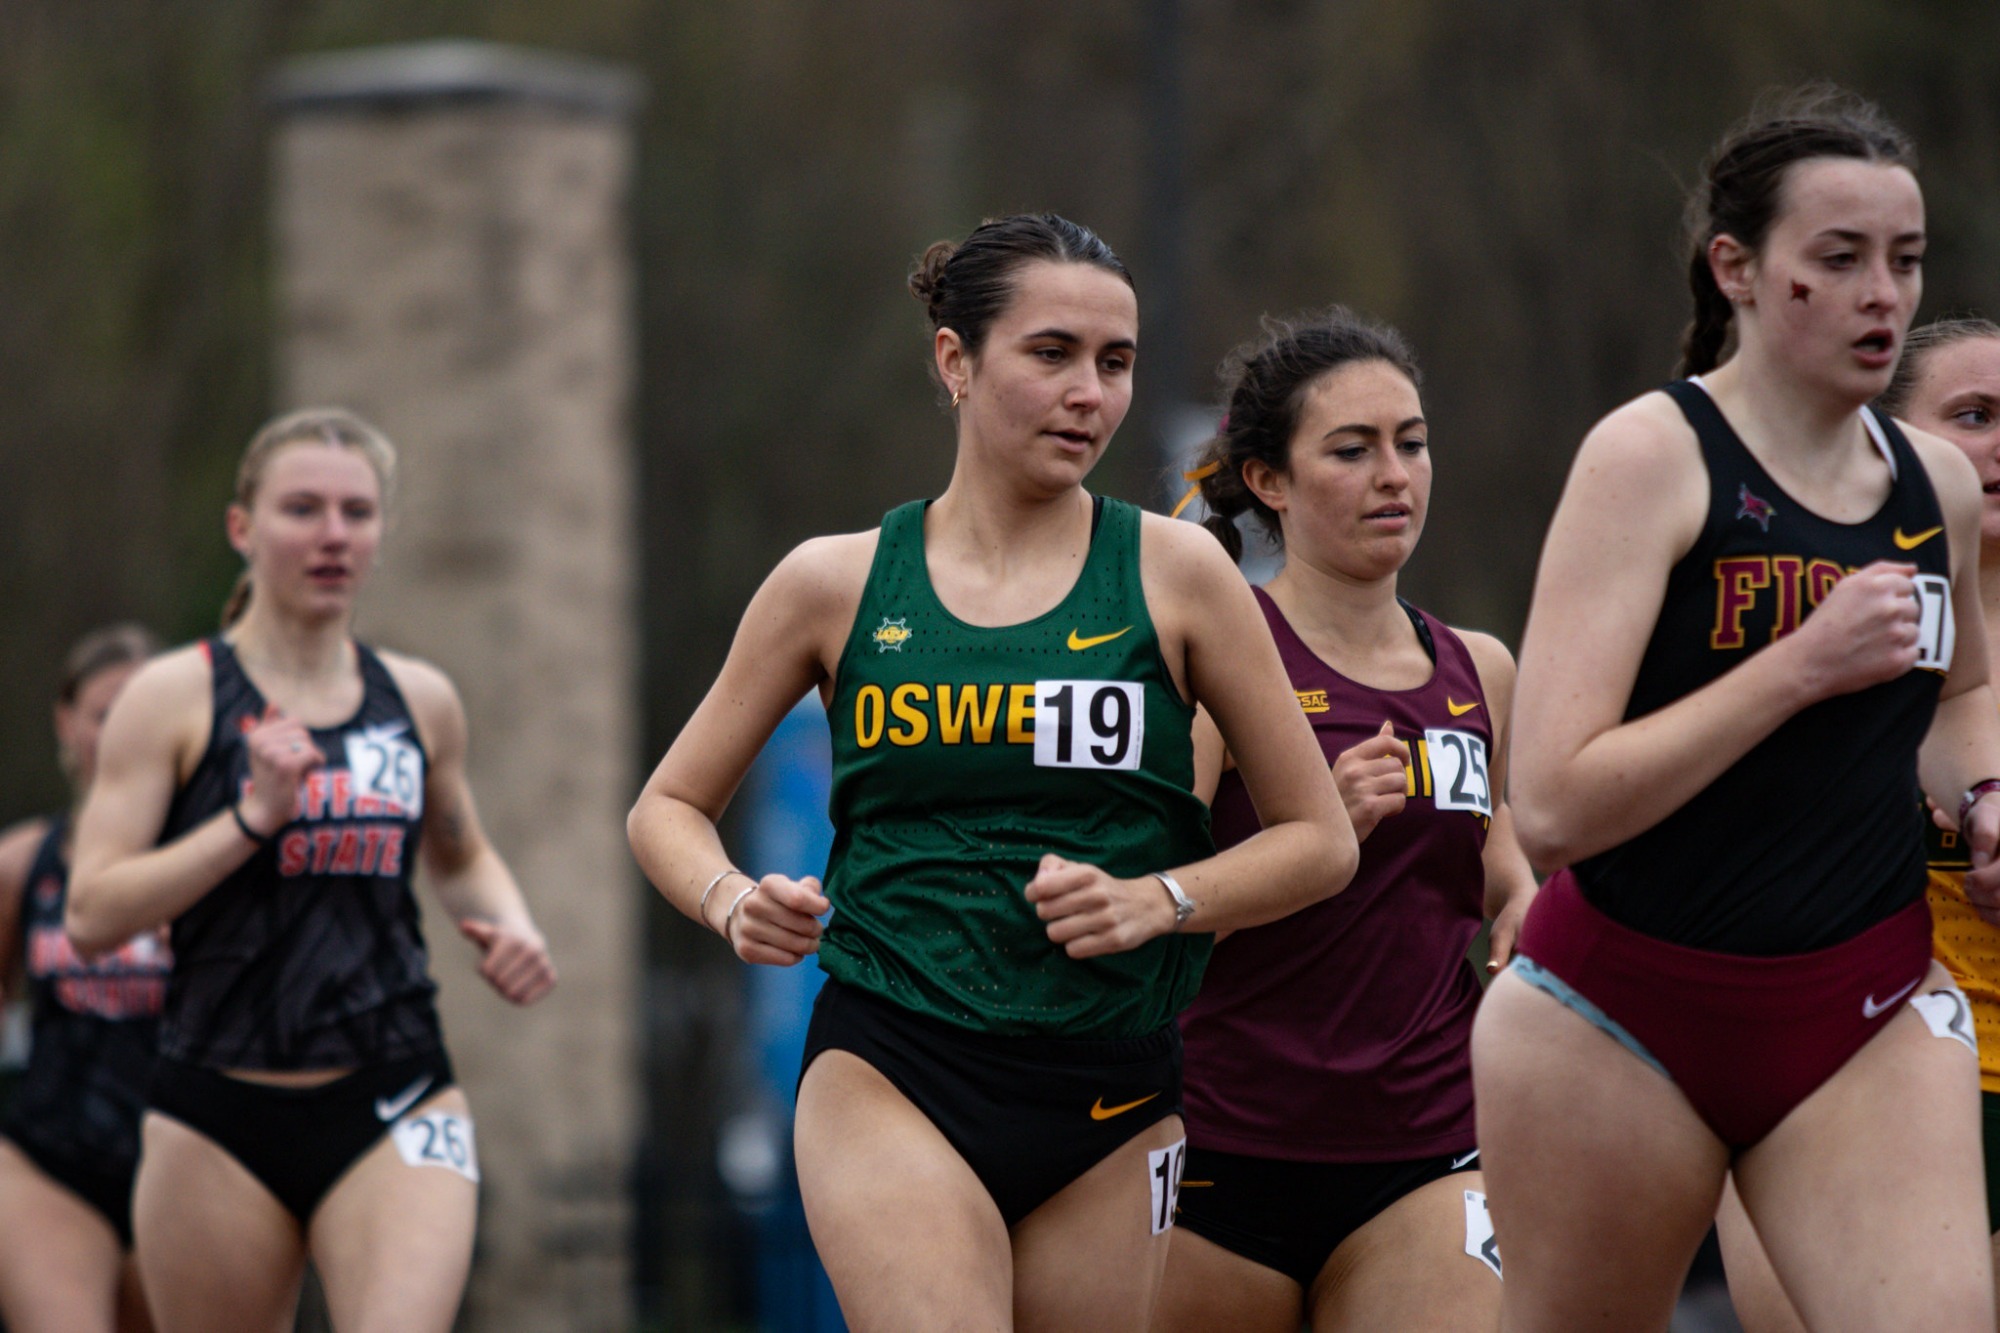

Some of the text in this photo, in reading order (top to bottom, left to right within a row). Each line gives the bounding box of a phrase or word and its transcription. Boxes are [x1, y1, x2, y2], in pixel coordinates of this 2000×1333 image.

[854, 683, 1036, 748] OSWE
[1044, 685, 1132, 765] 19
[1299, 695, 1329, 707] SAC
[363, 742, 415, 802] 26
[1441, 733, 1489, 809] 25
[278, 822, 406, 877] STATE
[409, 1117, 467, 1168] 26
